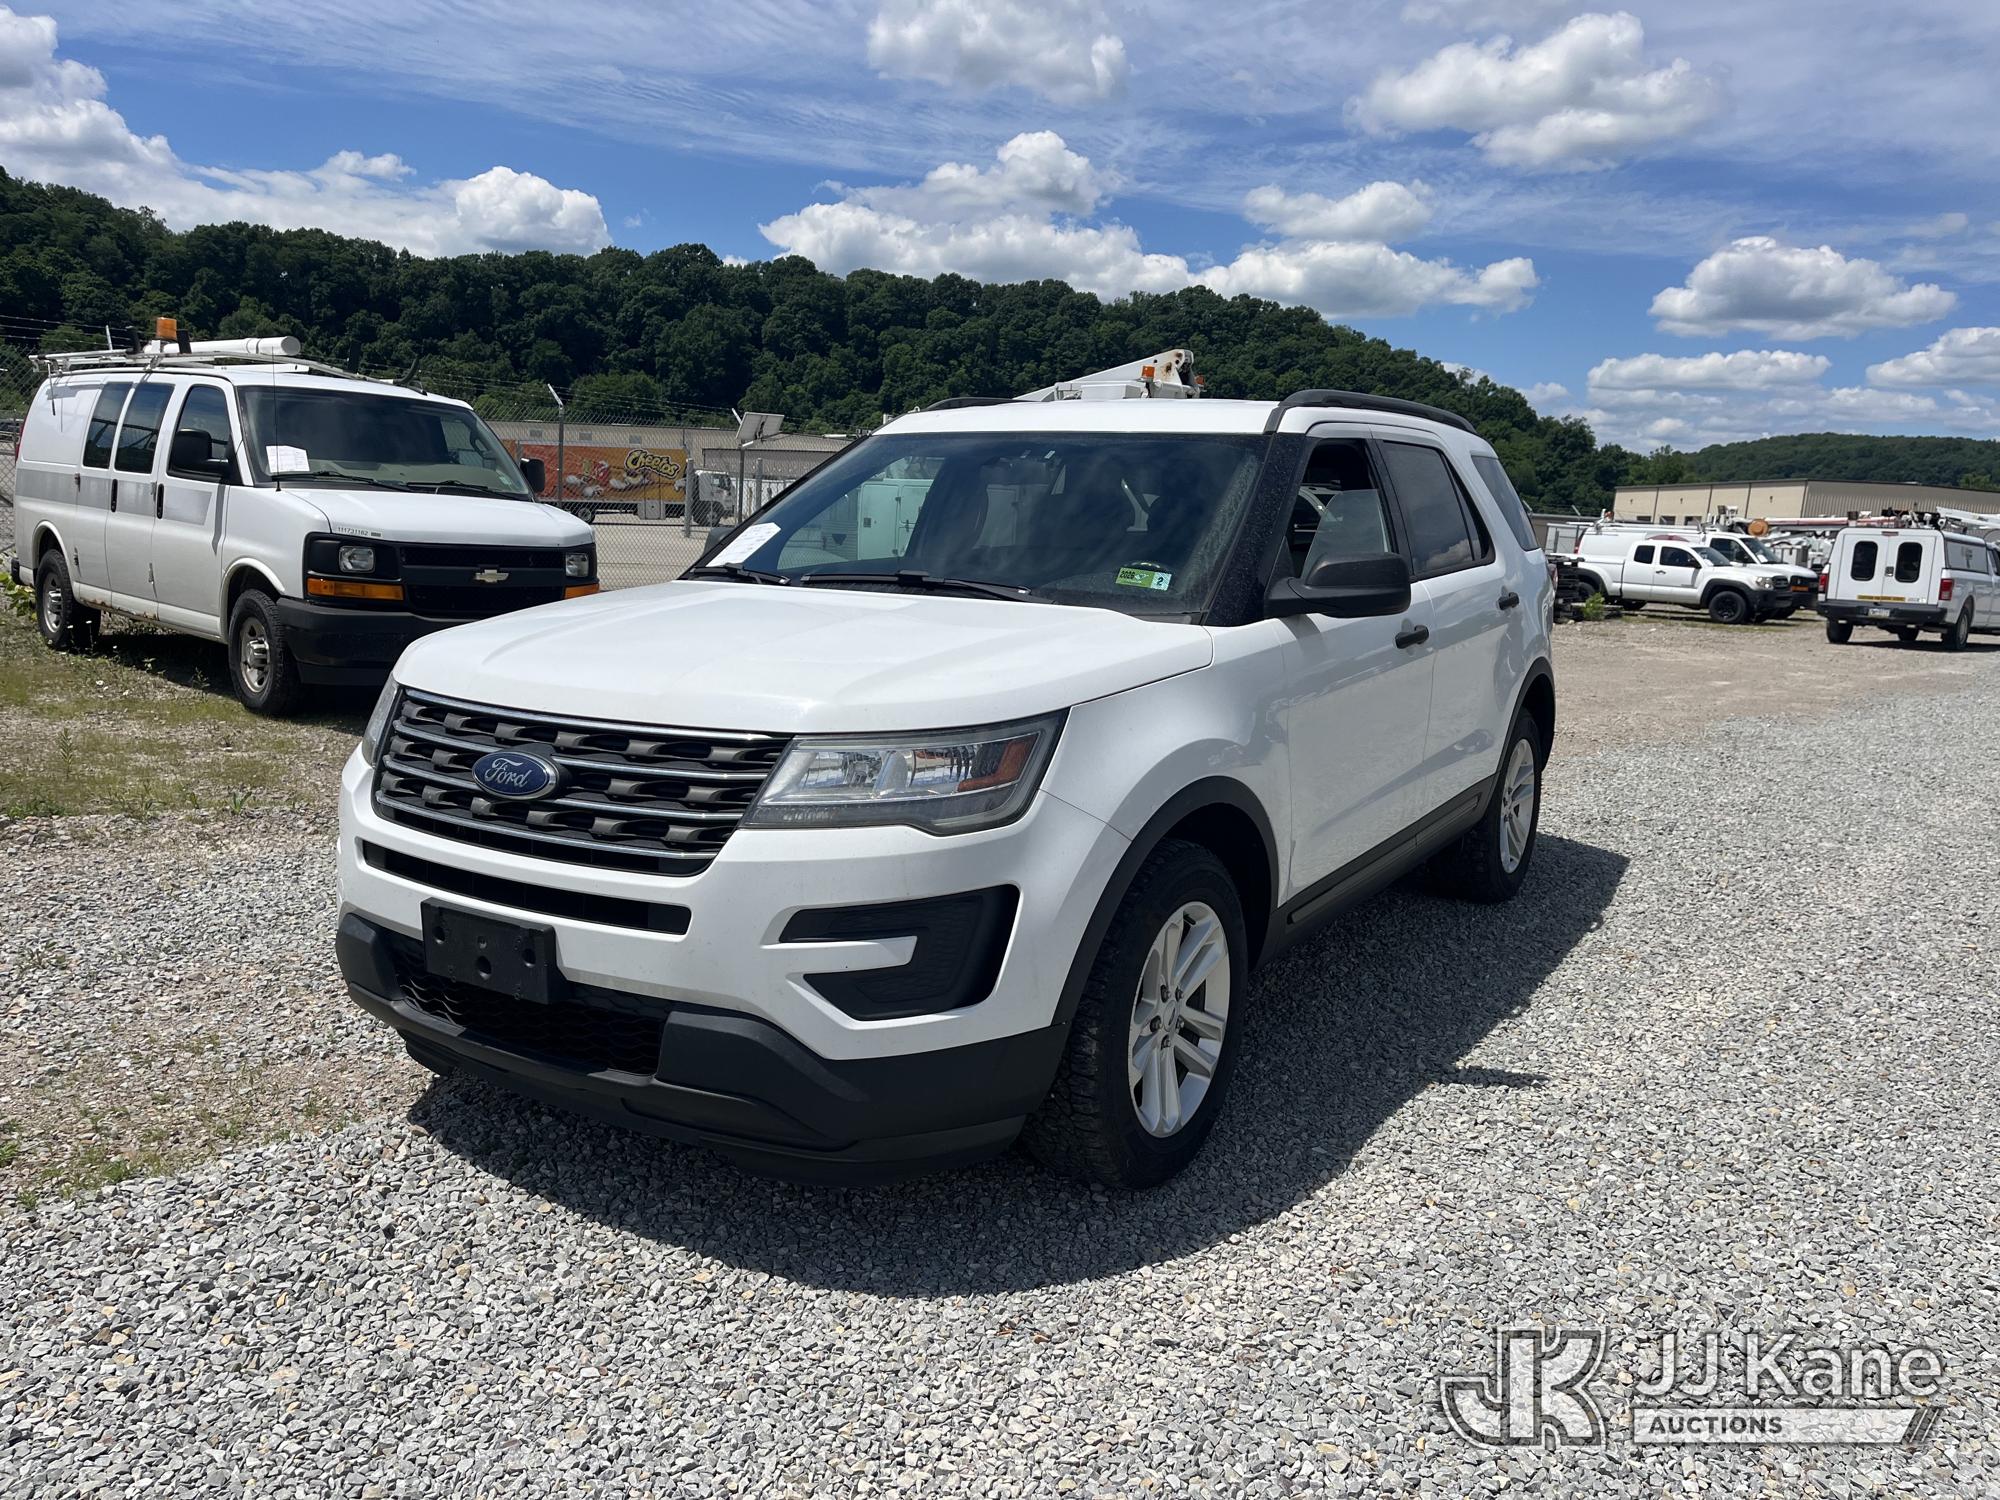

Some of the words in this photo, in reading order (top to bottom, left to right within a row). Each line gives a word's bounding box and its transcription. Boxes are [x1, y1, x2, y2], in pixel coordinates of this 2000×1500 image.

[625, 449, 680, 478] Cheetos
[1156, 576, 1164, 586] 2
[484, 757, 532, 788] Ford
